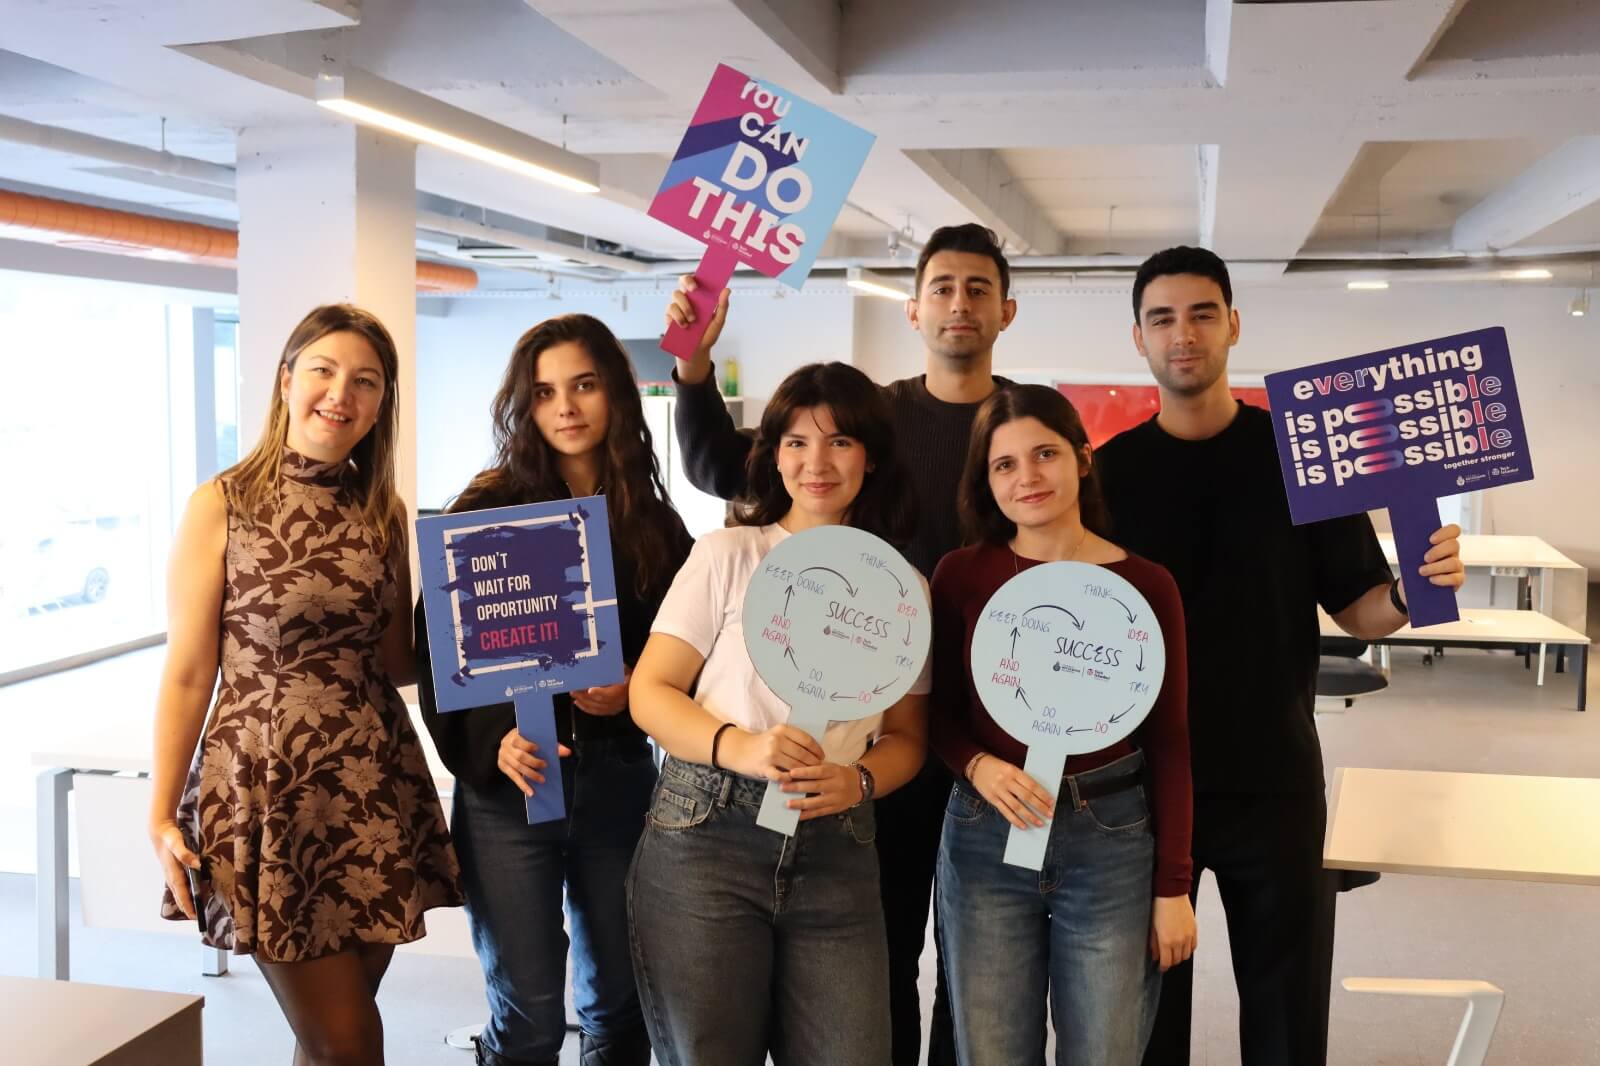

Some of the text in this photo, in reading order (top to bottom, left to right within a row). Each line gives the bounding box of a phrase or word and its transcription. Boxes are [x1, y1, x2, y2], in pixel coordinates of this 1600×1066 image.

[740, 112, 810, 161] CAN
[721, 141, 812, 214] DO
[688, 176, 806, 264] THIS
[1293, 344, 1483, 400] everything
[1284, 374, 1502, 436] is possible
[1290, 400, 1507, 461] is possible
[1295, 426, 1513, 487] is possible
[1444, 451, 1516, 470] together stronger
[471, 551, 508, 573] DON'T
[859, 552, 887, 568] THINK
[474, 575, 531, 597] WAIT FOR
[765, 563, 825, 595] KEEP DOING
[1083, 584, 1112, 598] THINK
[477, 595, 558, 621] OPPORTUNITY
[897, 603, 918, 619] IDEA
[771, 614, 791, 630] AND
[826, 601, 891, 638] SUCCESS
[988, 610, 1051, 633] KEEP DOING
[480, 622, 559, 650] CREATE IT!
[761, 628, 792, 647] AGAIN
[1127, 628, 1149, 642] IDEA
[1054, 636, 1123, 667] SUCCESS
[895, 655, 914, 670] TRY
[1000, 658, 1019, 672] AND
[809, 668, 823, 681] DO
[991, 673, 1021, 688] AGAIN
[797, 681, 826, 700] AGAIN
[858, 691, 872, 703] DO
[1130, 681, 1149, 696] TRY
[1042, 706, 1056, 718] DO
[1032, 720, 1061, 736] AGAIN
[1094, 722, 1109, 733] DO
